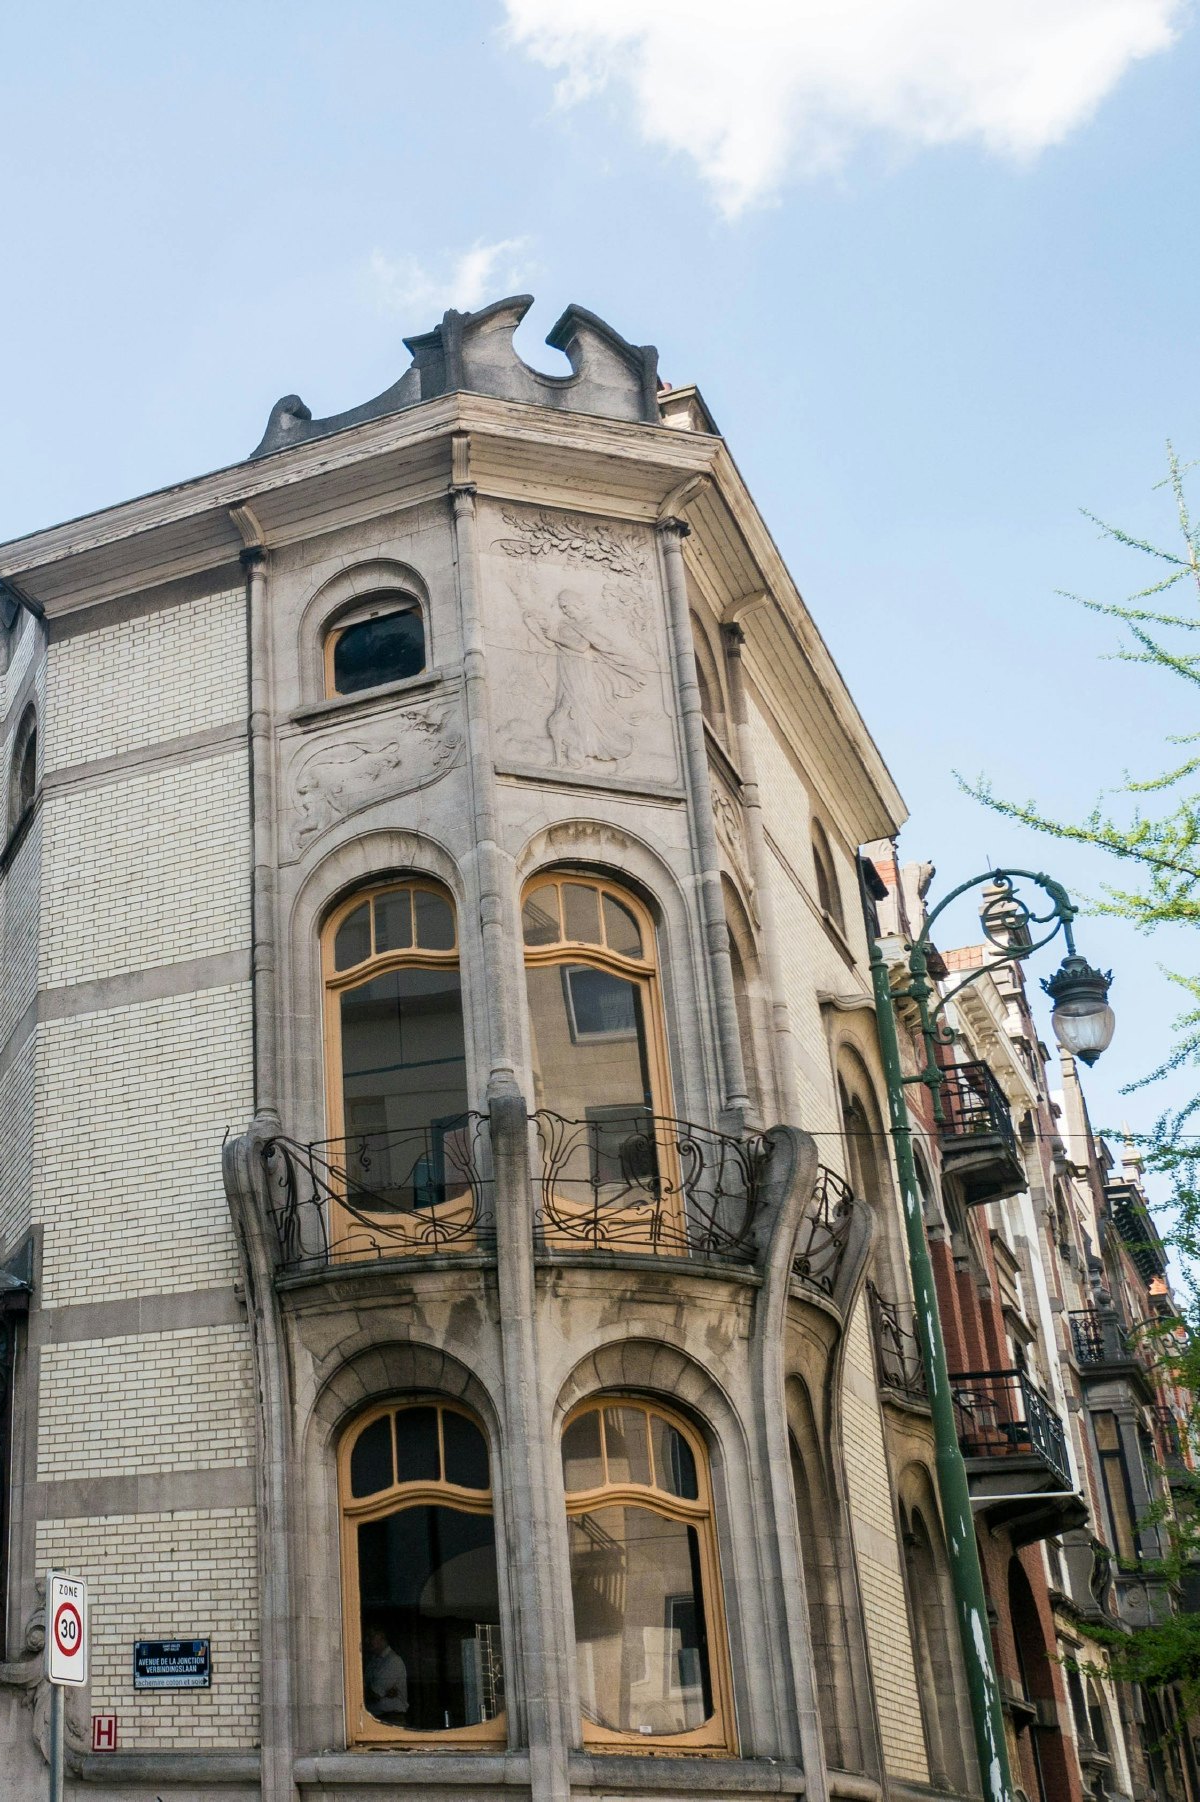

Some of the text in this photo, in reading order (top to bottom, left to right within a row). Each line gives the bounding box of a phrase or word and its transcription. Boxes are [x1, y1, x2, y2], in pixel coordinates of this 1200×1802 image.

[59, 1584, 78, 1598] ZONE
[61, 1618, 76, 1640] 30
[138, 1658, 159, 1666] AVENUE
[177, 1656, 205, 1665] JONCTION
[145, 1665, 197, 1673] VERBINDINGSLAAN
[96, 1719, 113, 1746] H
